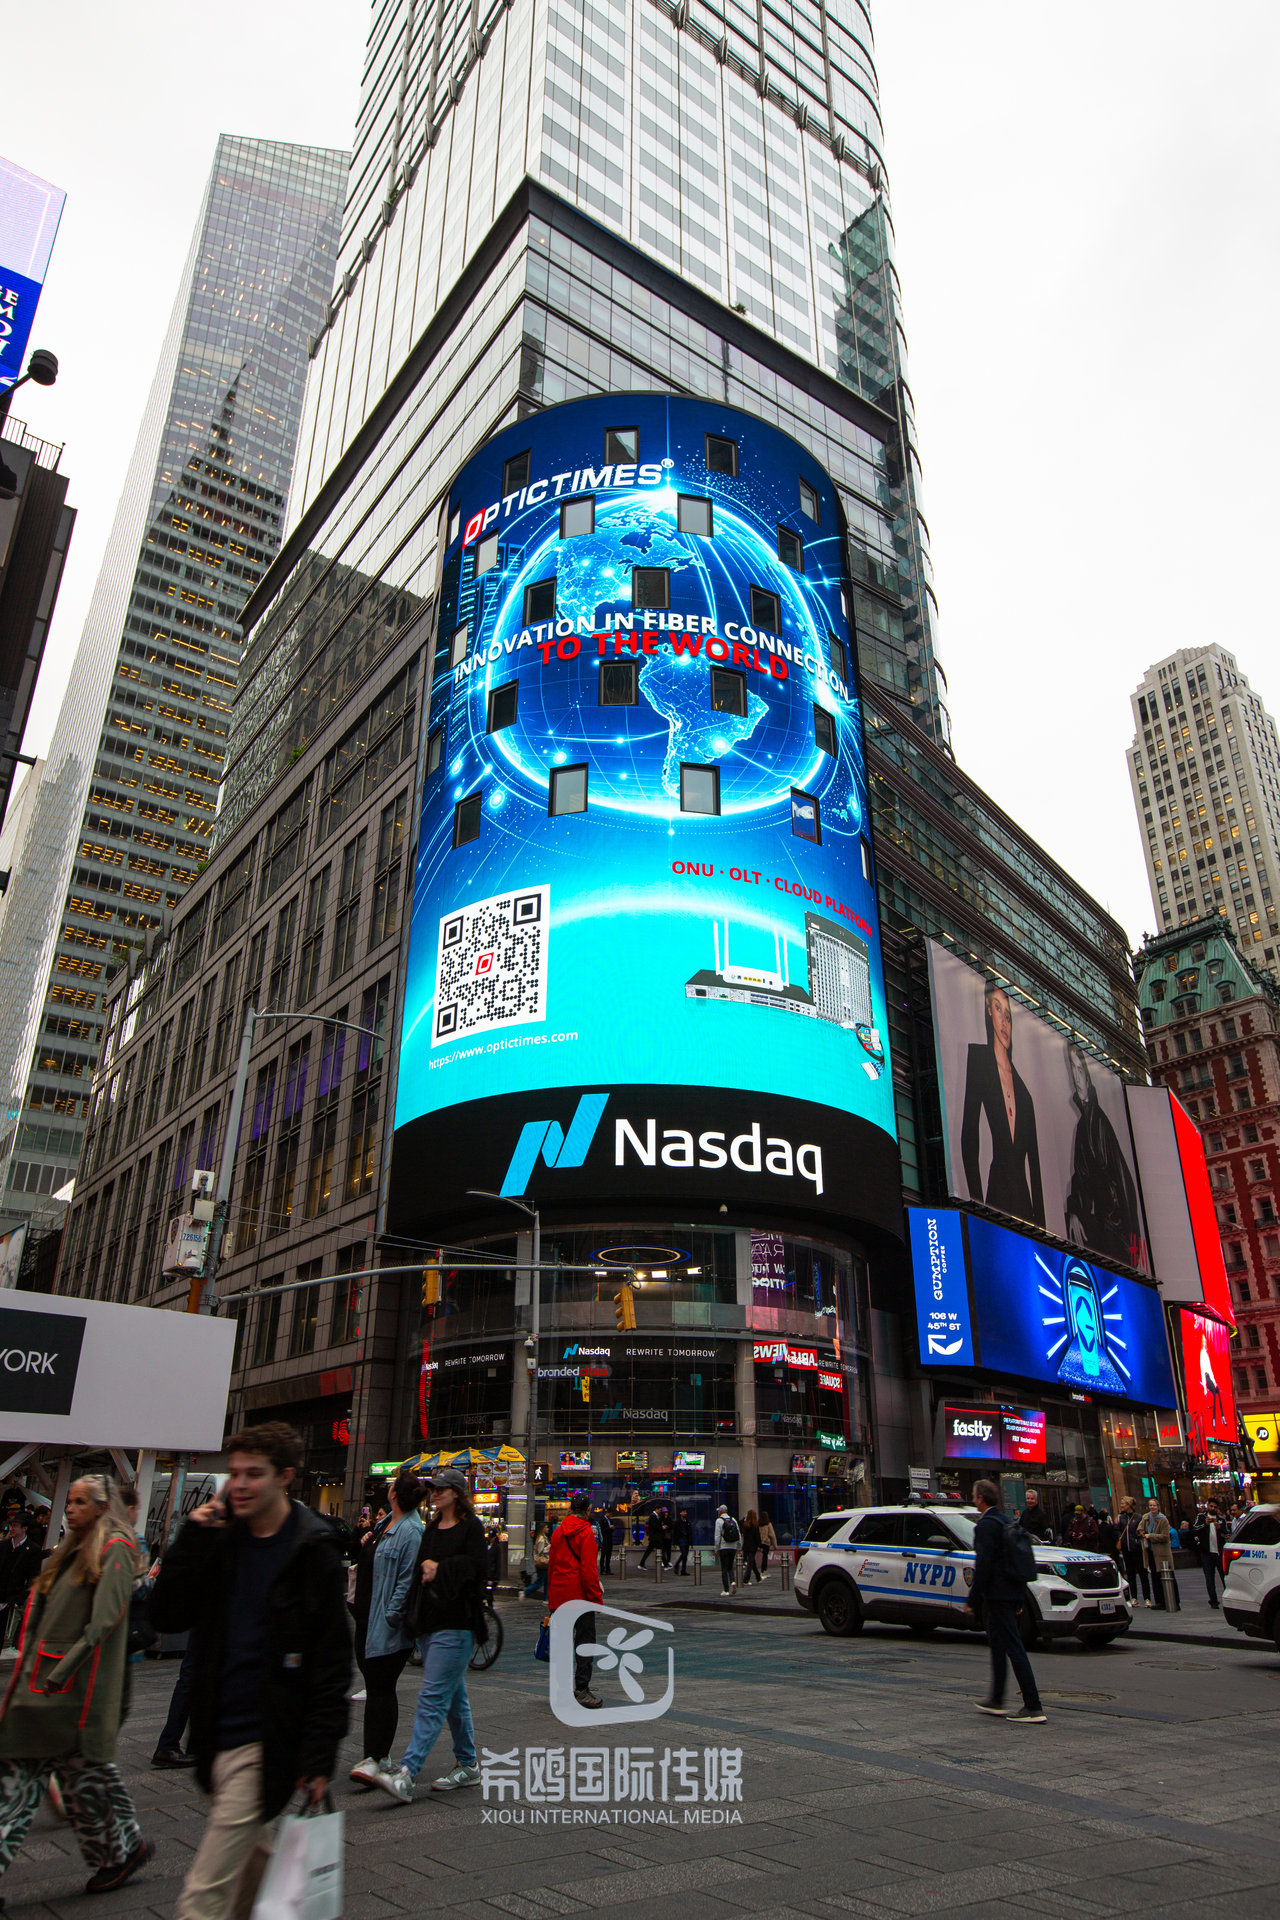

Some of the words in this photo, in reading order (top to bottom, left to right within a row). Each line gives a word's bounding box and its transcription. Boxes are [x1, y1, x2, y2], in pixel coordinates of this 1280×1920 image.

[453, 614, 596, 684] INNOVATION
[605, 611, 634, 631] IN
[643, 612, 717, 636] FIBER
[723, 622, 850, 703] CONNECTION
[538, 637, 582, 666] TO
[592, 631, 659, 656] THE
[669, 632, 789, 681] WORLD
[671, 860, 714, 877] ONU
[729, 867, 762, 885] OLT
[774, 877, 822, 904] CLOUD
[825, 895, 873, 939] PLATFORM
[428, 1031, 579, 1071] https://www.optictimes.com
[614, 1117, 825, 1196] Nasdaq
[927, 1217, 944, 1301] GUMPTION
[940, 1245, 948, 1274] COFFEE
[927, 1321, 948, 1331] 45TH
[948, 1322, 962, 1331] ST
[929, 1312, 947, 1320] 106
[947, 1312, 958, 1320] W
[578, 1346, 611, 1357] Nasdaq
[626, 1347, 664, 1356] REWRITE
[667, 1348, 716, 1358] TOMORROW
[622, 1407, 668, 1422] Nasdaq
[1257, 1429, 1269, 1439] JD
[903, 1561, 957, 1588] NYPD
